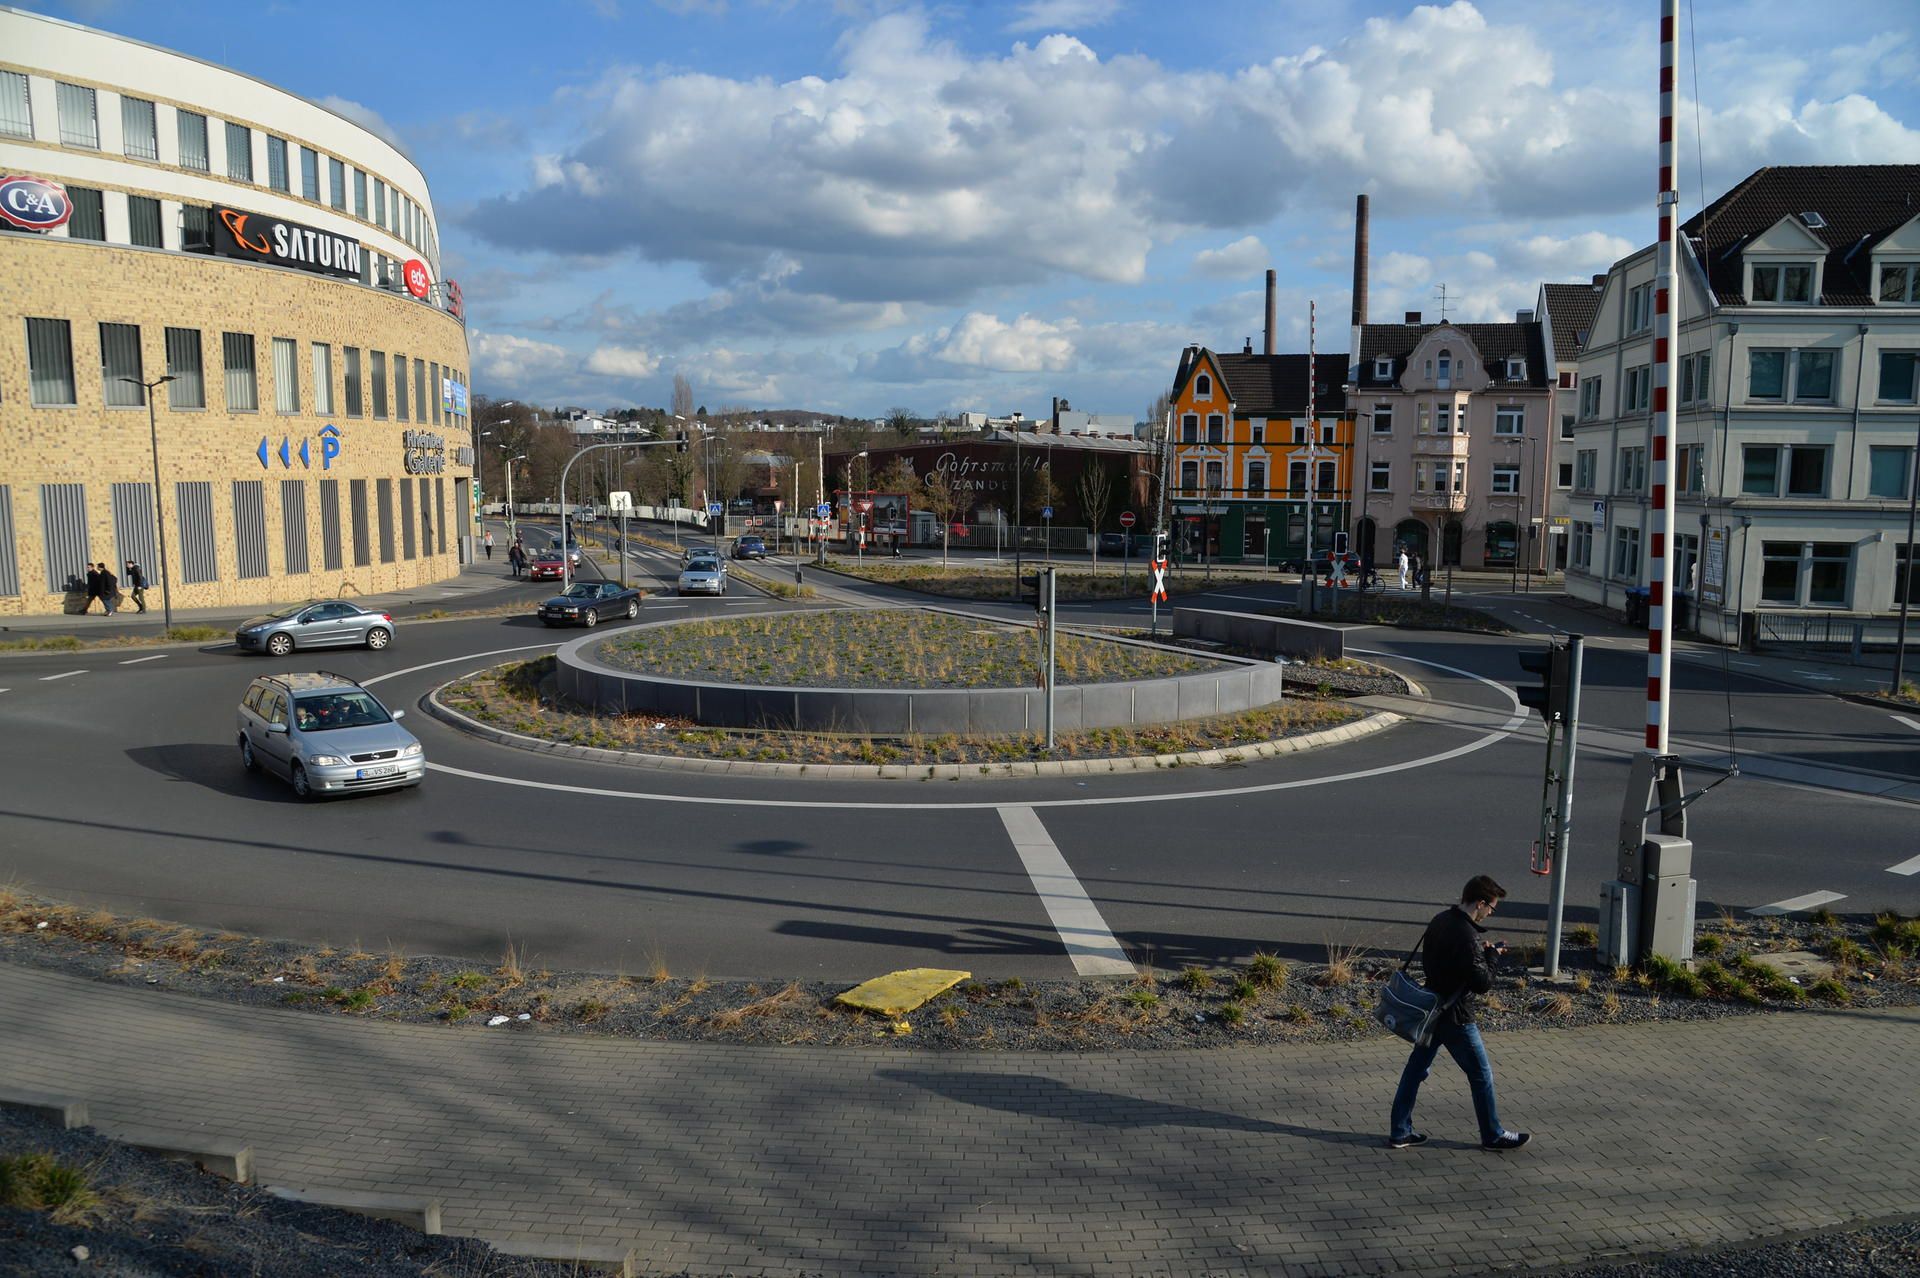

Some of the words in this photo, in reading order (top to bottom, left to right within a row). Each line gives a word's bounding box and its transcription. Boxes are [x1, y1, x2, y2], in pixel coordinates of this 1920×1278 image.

[8, 187, 59, 216] C&A
[274, 223, 361, 272] SATURN
[410, 267, 426, 288] edc
[322, 437, 340, 470] P
[1554, 711, 1561, 720] 2
